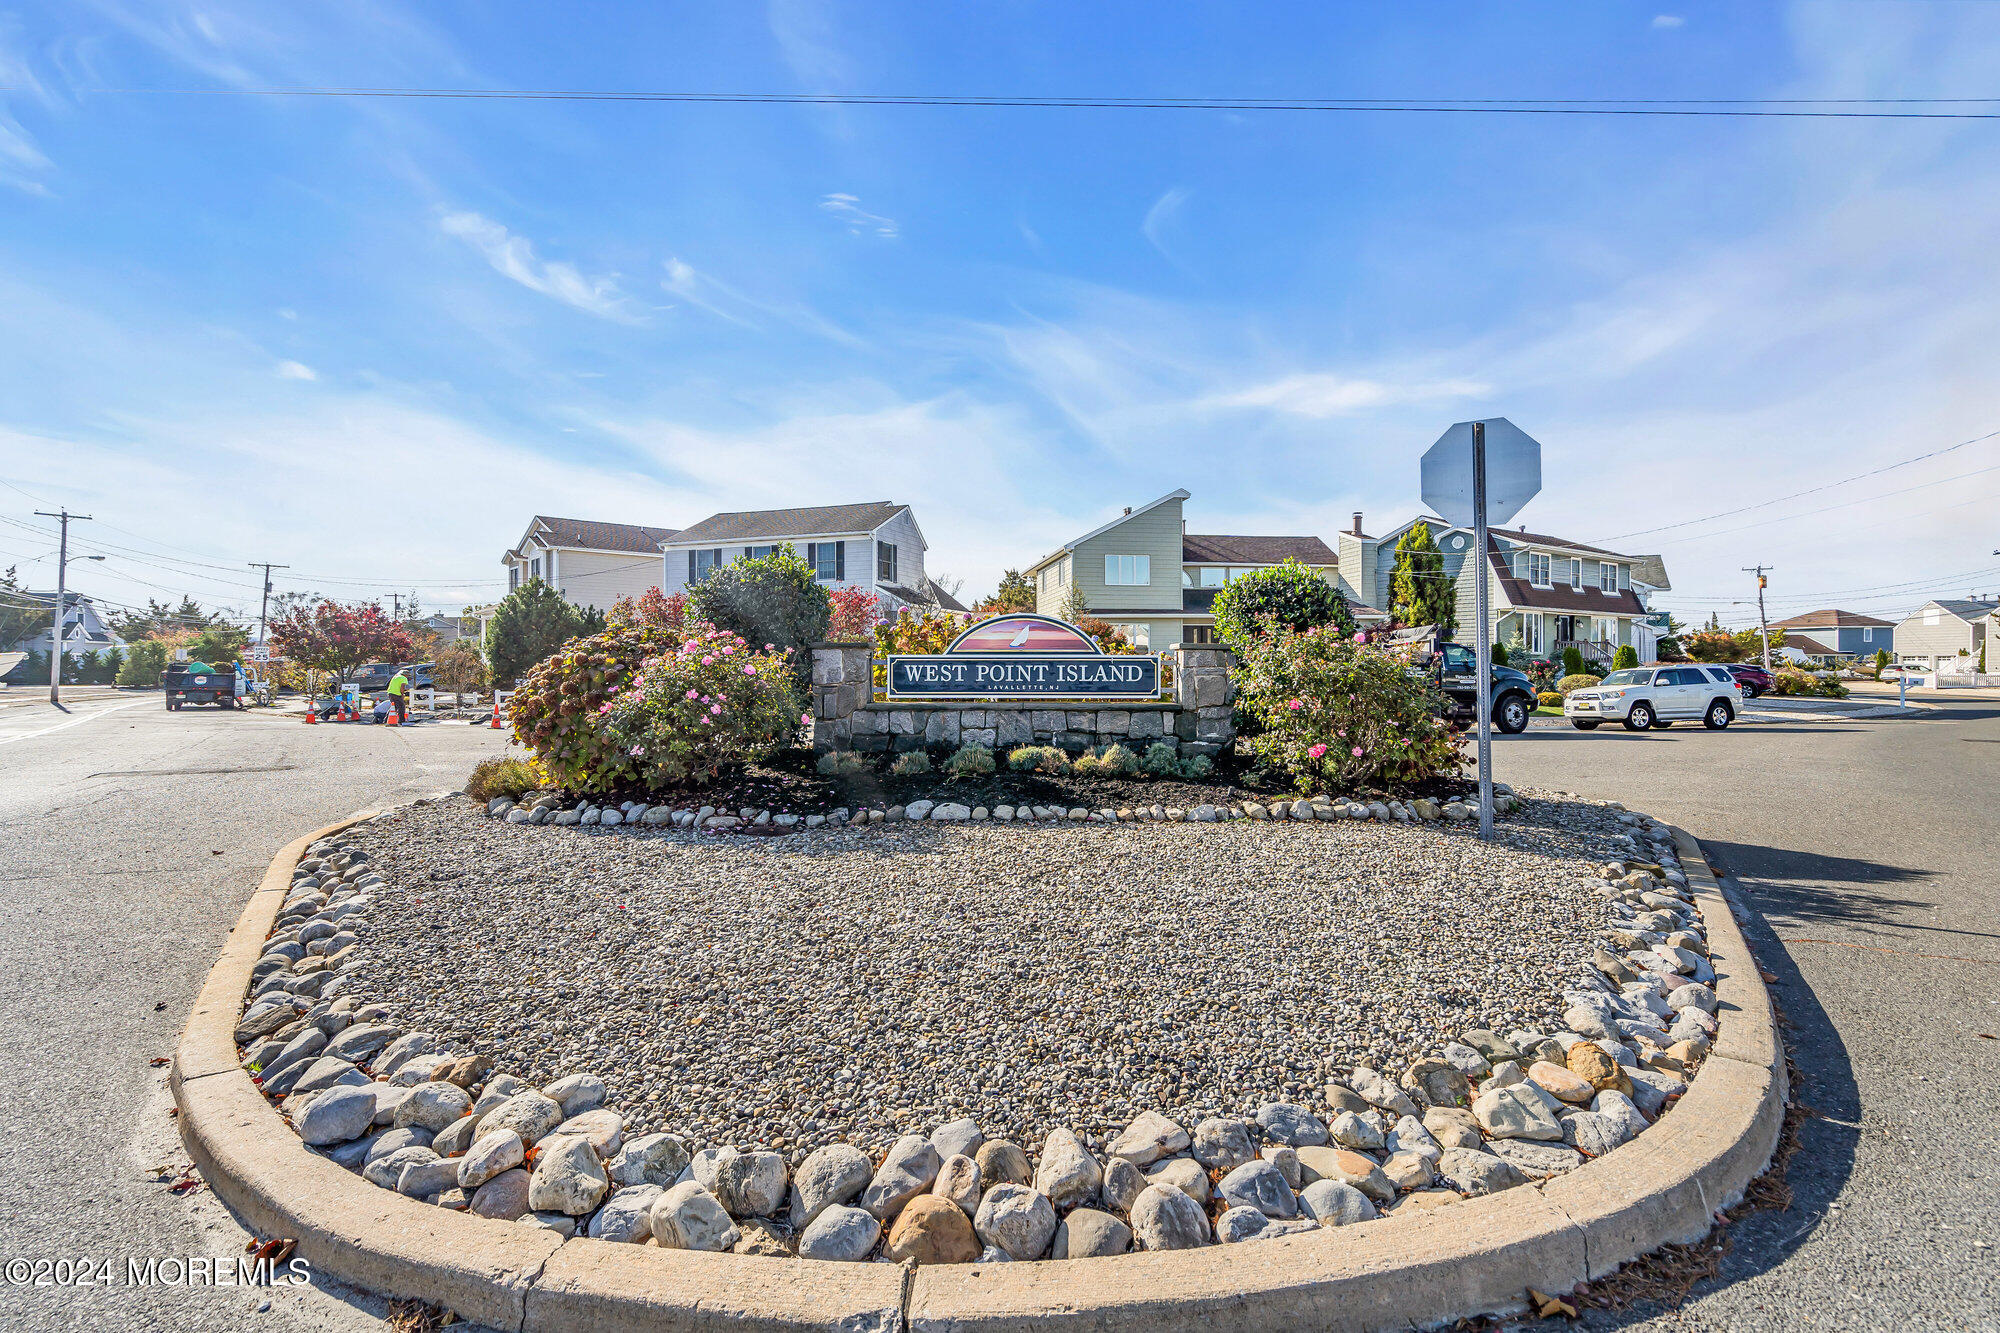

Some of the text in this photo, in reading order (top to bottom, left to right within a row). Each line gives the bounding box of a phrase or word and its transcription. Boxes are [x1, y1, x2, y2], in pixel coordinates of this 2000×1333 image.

[903, 664, 1143, 682] WEST POINT ISLAND
